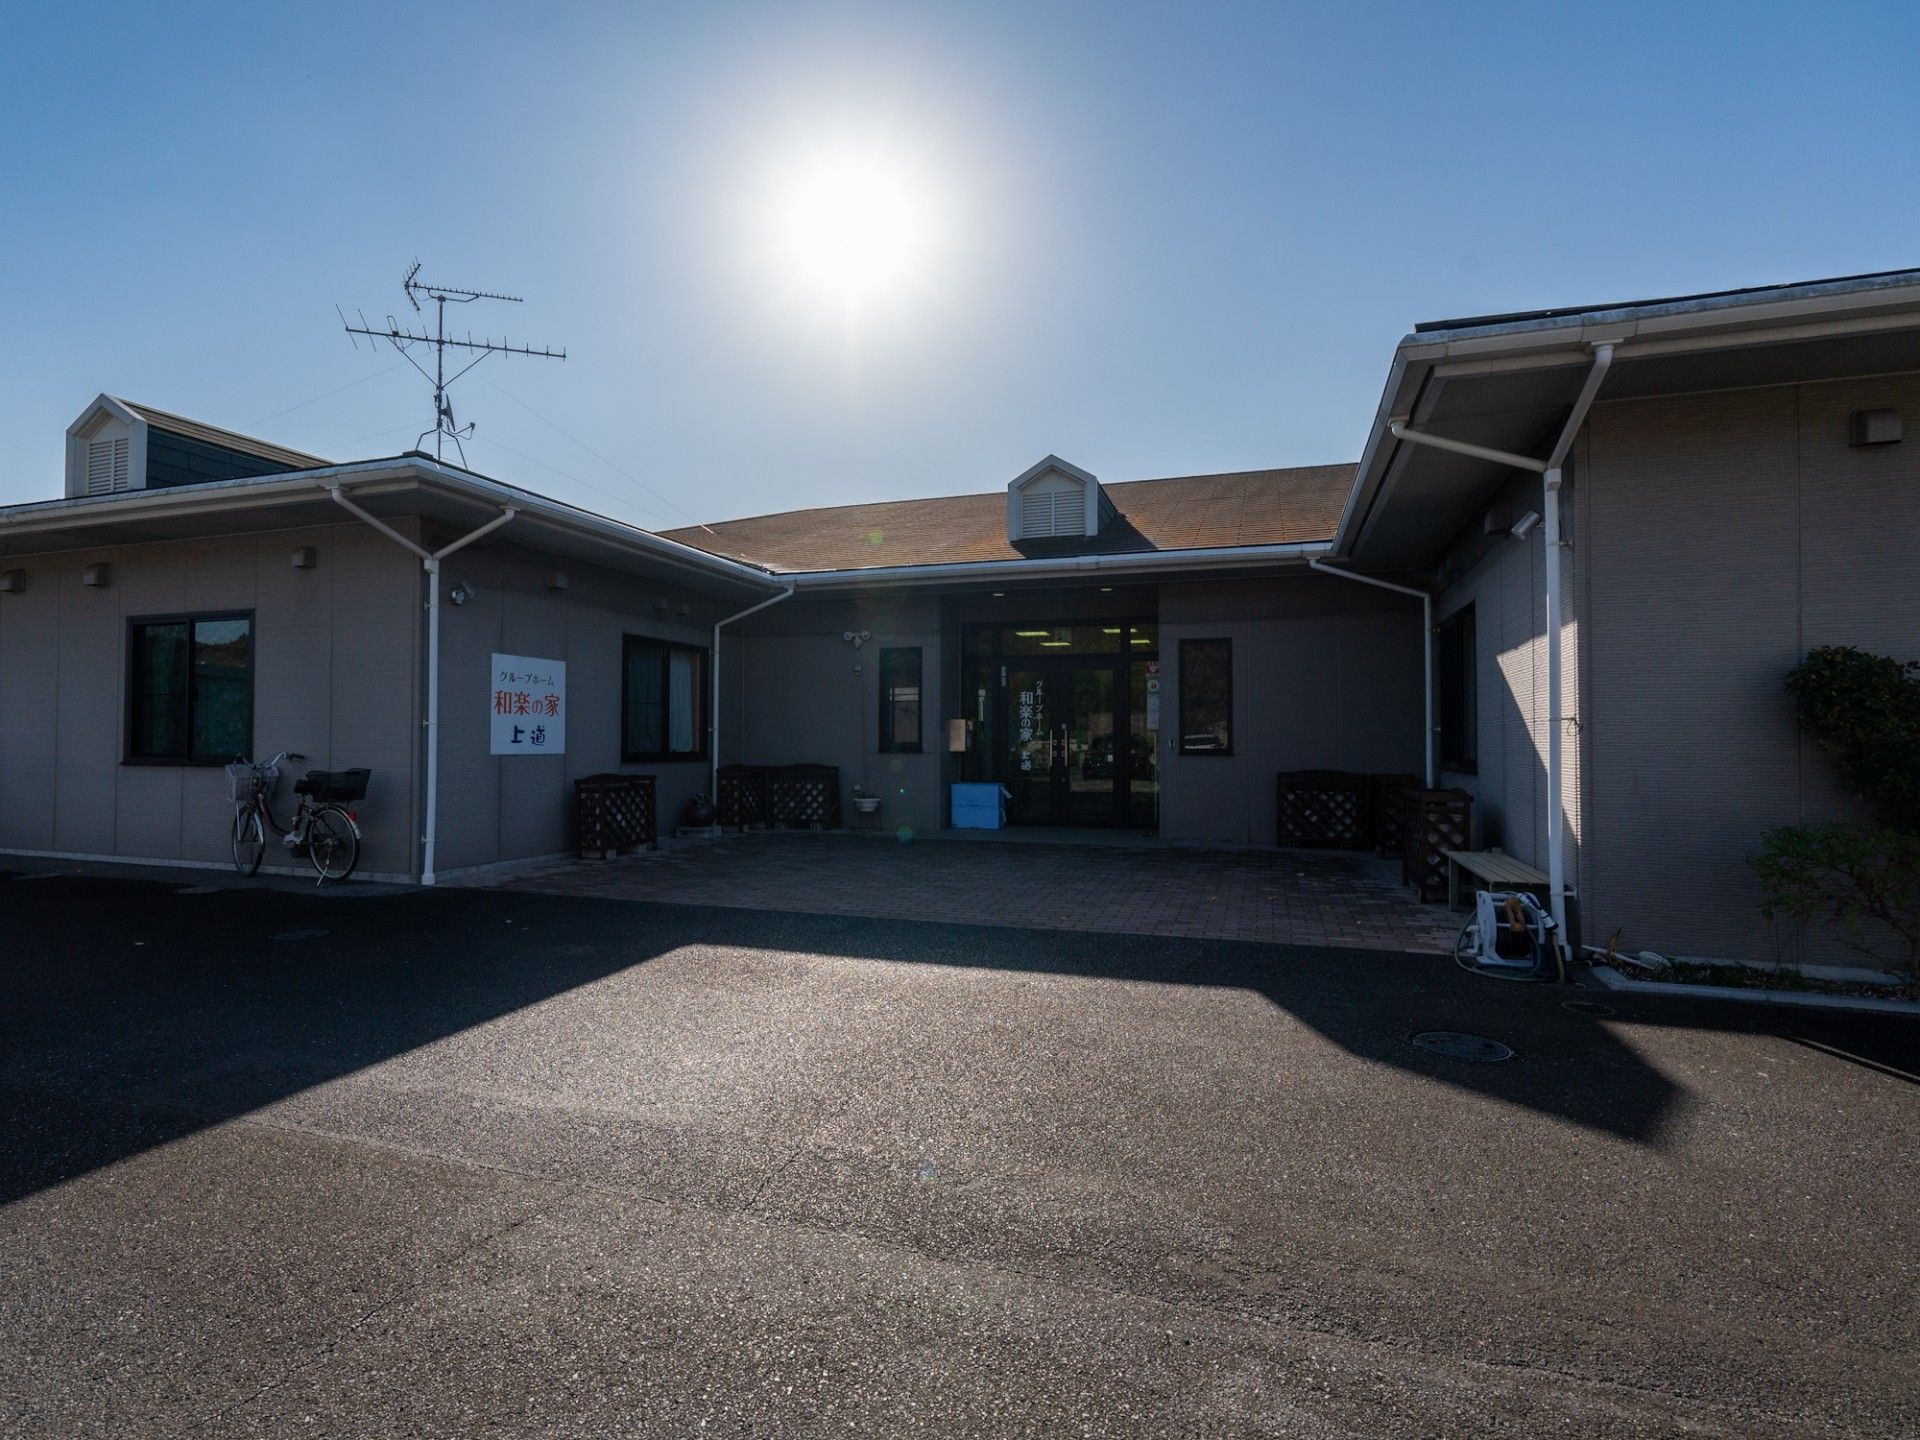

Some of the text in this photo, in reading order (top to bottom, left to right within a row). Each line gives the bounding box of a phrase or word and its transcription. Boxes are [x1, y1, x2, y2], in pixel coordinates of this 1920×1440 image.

[500, 671, 554, 686] グループホーム
[494, 690, 560, 717] 和楽の家
[1019, 690, 1034, 742] 和楽の家
[1035, 680, 1044, 737] グループホーム
[511, 724, 546, 746] 上道
